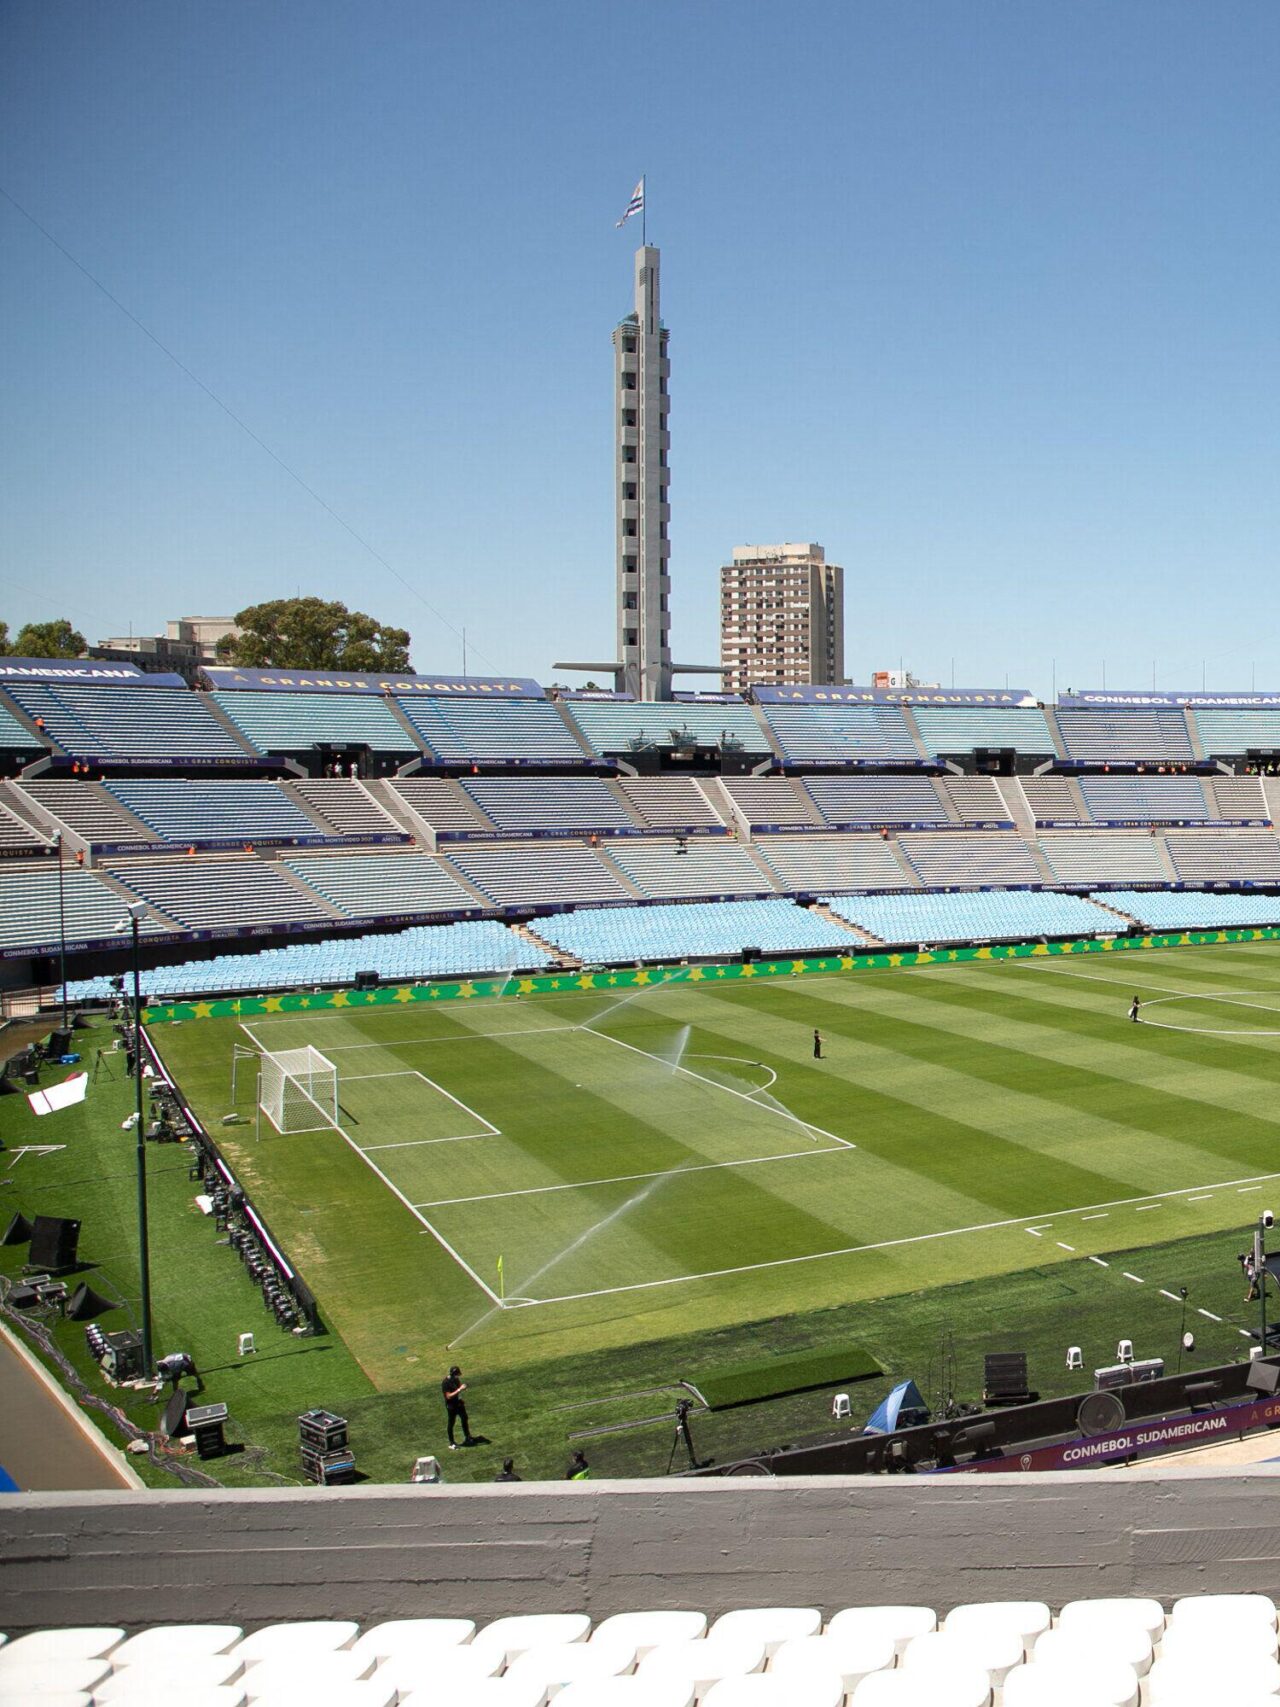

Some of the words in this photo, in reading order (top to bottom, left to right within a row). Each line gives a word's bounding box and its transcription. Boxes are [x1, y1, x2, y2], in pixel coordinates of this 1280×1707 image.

[260, 676, 369, 688] GRANDE
[380, 682, 523, 691] CONQUISTA
[891, 676, 895, 685] G
[779, 690, 803, 698] LA
[816, 693, 874, 701] GRAN
[1084, 694, 1172, 703] CONMEBOL
[416, 912, 454, 920] CONQUISTA
[304, 921, 333, 929] CONMEBOL
[335, 918, 374, 926] SUDAMERICANA
[138, 934, 180, 943] CONQUISTA
[3, 947, 39, 957] CONMEBOL
[1251, 1409, 1259, 1420] A
[1063, 1437, 1133, 1462] CONMEBOL
[1136, 1417, 1228, 1445] SUDAMERICANA
